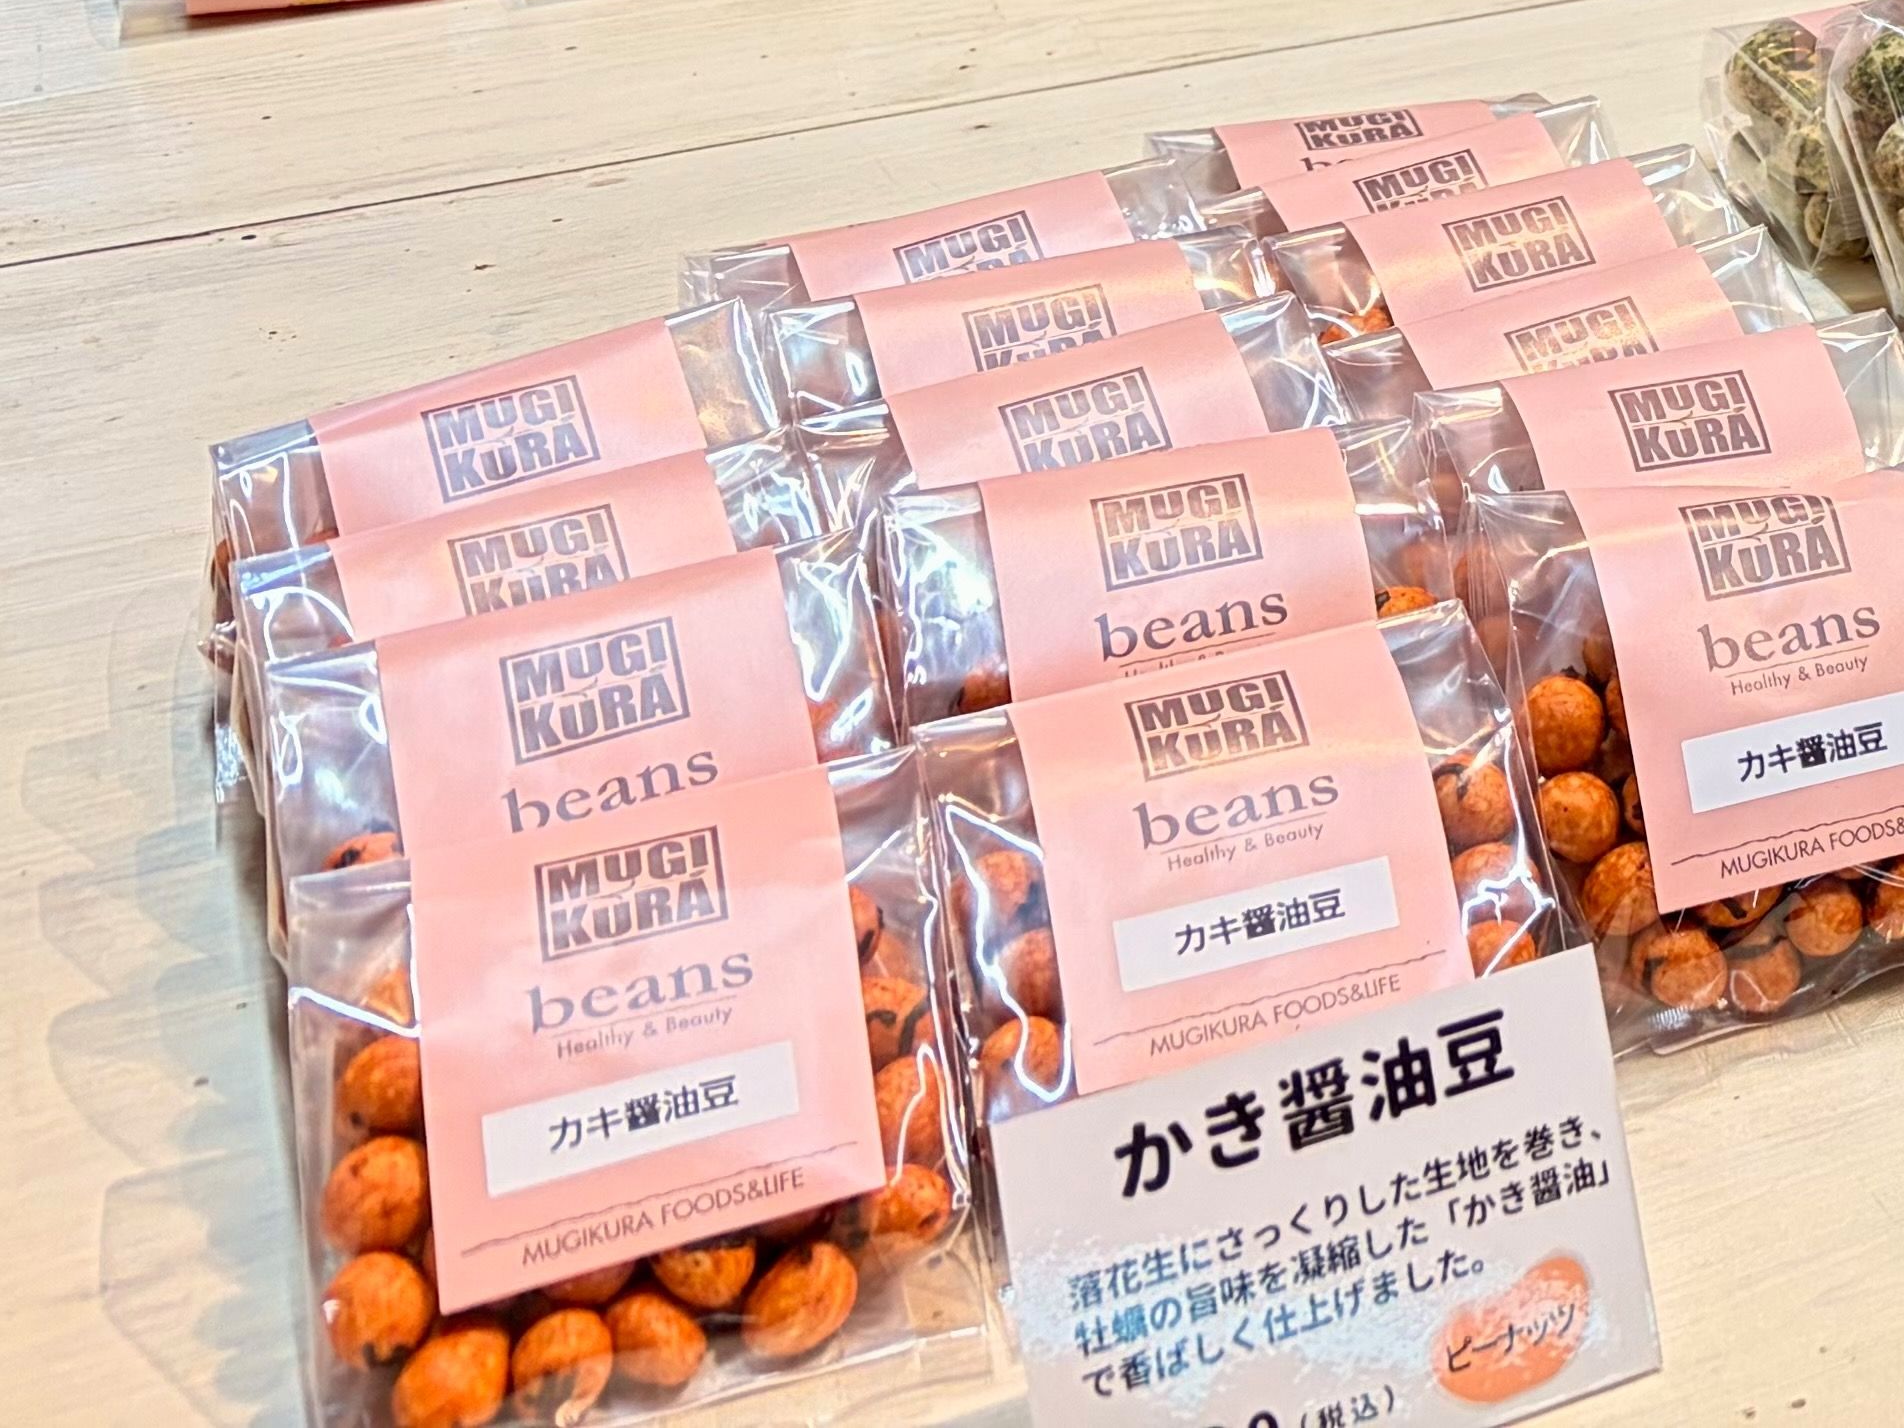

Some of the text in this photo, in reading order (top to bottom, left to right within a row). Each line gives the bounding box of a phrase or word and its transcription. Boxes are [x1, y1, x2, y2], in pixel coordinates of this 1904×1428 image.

[1369, 154, 1477, 199] MUGI
[906, 217, 1028, 277] MUGI
[1454, 199, 1572, 256] MUGI
[977, 288, 1099, 345] MUGI
[441, 382, 577, 449] MUGI
[1015, 375, 1147, 430] MUGI
[1620, 373, 1747, 425] MUGI
[446, 426, 594, 494] KURA
[1634, 414, 1764, 465] KURA
[1105, 478, 1245, 537] MUGI
[1692, 496, 1825, 542] MUGI
[462, 511, 607, 576] MUGI
[1109, 522, 1260, 582] KURA
[1704, 522, 1841, 592] KURA
[1095, 593, 1288, 662] beans
[1698, 606, 1881, 672] beans
[514, 622, 670, 702] MUGI
[1731, 656, 1868, 697] Healthy & Beauty
[517, 673, 680, 757] KURA
[1138, 676, 1287, 732] MUGI
[1146, 715, 1298, 774] KURA
[501, 748, 718, 833] beans
[1132, 775, 1340, 850] beans
[548, 833, 709, 904] MUGI
[1167, 824, 1325, 873] Healthy & Beauty
[1720, 838, 1824, 878] MUGIKURA
[550, 876, 717, 951] KURA
[1175, 890, 1347, 955] カキ醤油豆
[528, 953, 753, 1034] beans
[1150, 975, 1402, 1056] MUGIKURA FOODS&LIFE
[556, 1006, 733, 1060] Healthy & Beauty
[1114, 1009, 1515, 1199] かき醤油豆
[521, 1168, 805, 1267] MUGIKURA FOODS&LIFE
[1069, 1114, 1603, 1314] 落花生にさっくりした生地を巻き、
[1074, 1158, 1612, 1358] 牡蠣の旨味を凝縮した「かき醤油」
[1084, 1257, 1486, 1399] で香ばしく仕上げました。
[1445, 1302, 1580, 1374] ピーナッツ
